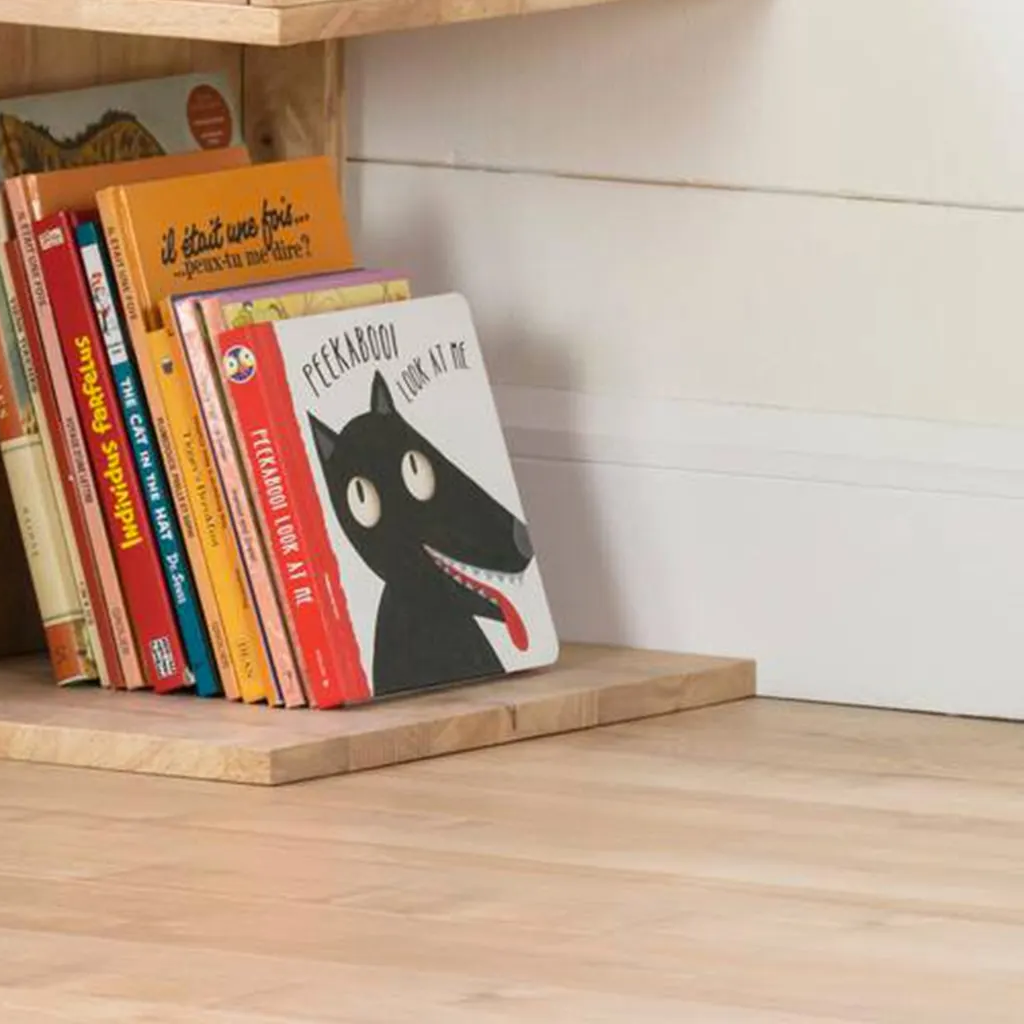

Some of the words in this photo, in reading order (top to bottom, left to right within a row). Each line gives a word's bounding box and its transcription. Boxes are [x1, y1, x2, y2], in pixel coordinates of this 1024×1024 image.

[160, 225, 176, 264] il
[182, 216, 224, 257] était
[227, 217, 258, 244] une
[246, 250, 269, 266] me
[273, 234, 313, 262] dire?
[395, 357, 431, 403] LOOK
[428, 344, 448, 375] AT
[449, 341, 471, 370] ME
[119, 377, 137, 407] THE
[129, 413, 147, 445] CAT
[138, 450, 152, 468] IN
[144, 473, 161, 500] THE
[154, 507, 172, 541] HAT
[273, 515, 299, 554] LOOK
[286, 559, 305, 579] AT
[171, 572, 187, 604] Seuss
[292, 586, 312, 605] ME
